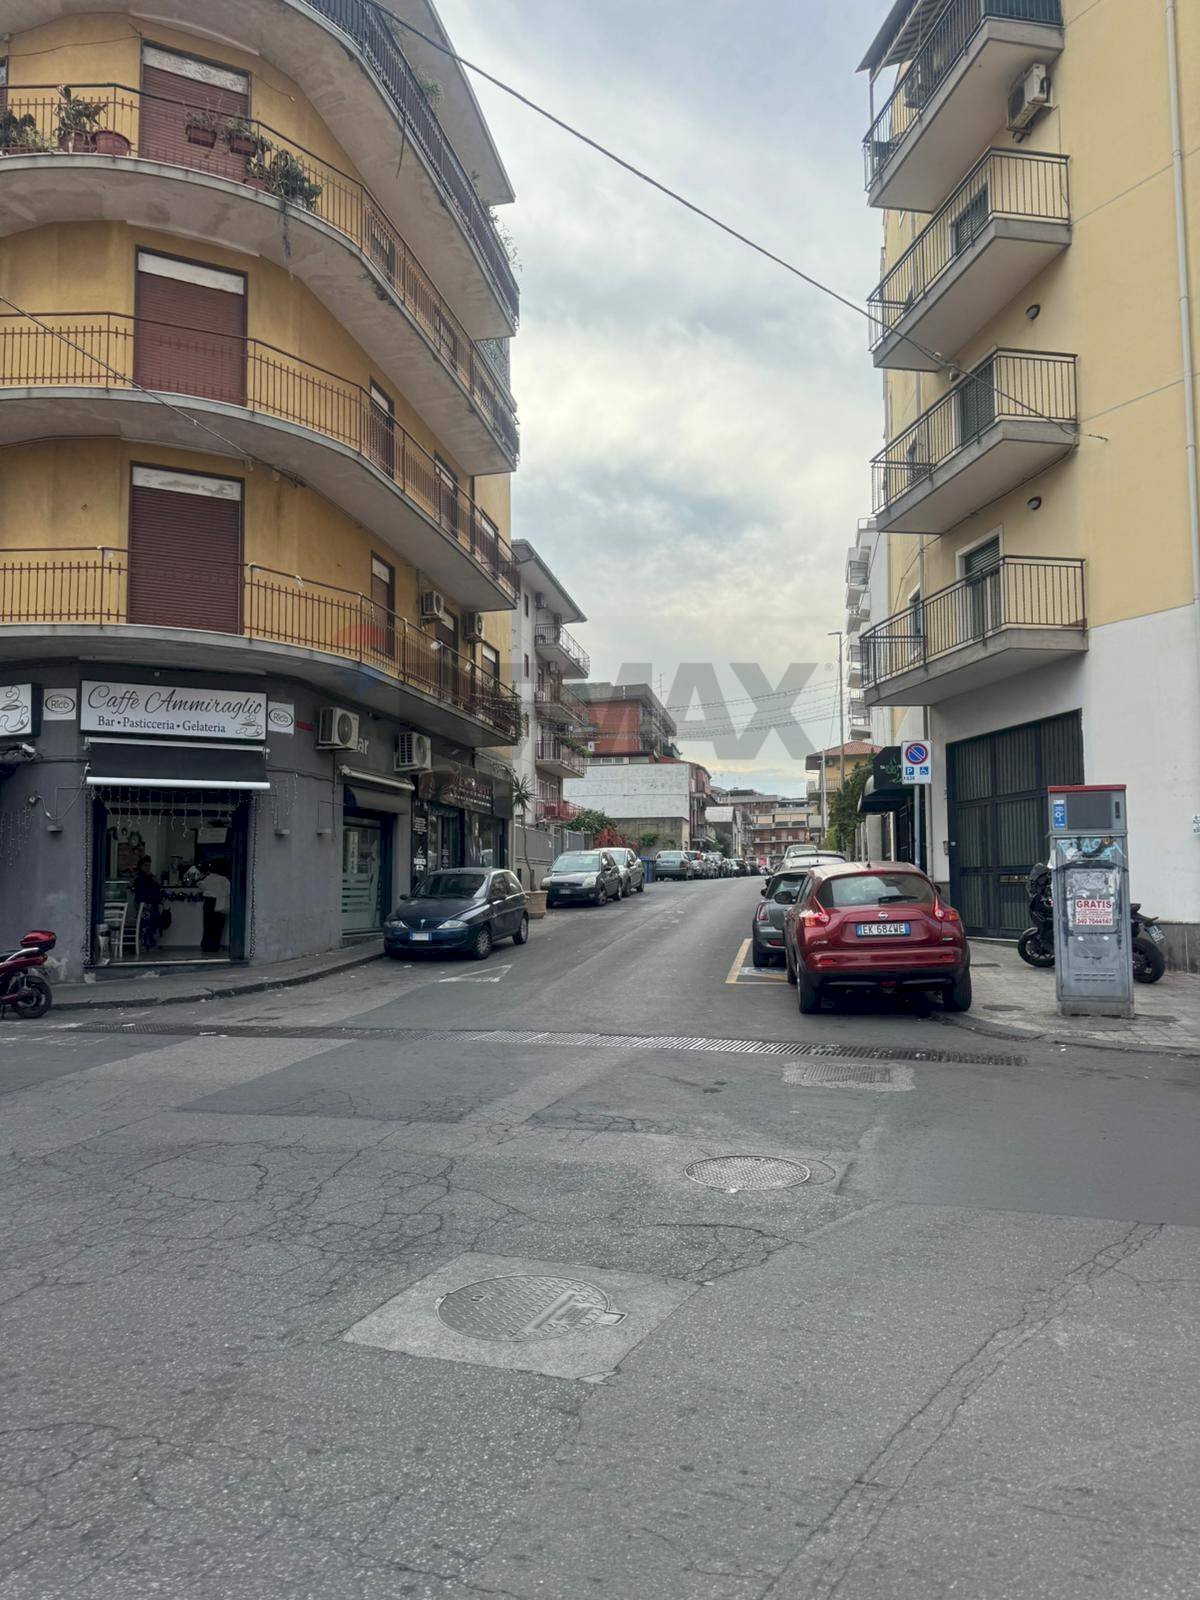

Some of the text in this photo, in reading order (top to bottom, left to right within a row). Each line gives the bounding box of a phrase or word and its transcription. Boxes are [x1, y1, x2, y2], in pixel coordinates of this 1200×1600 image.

[145, 689, 262, 720] Ammiraglio
[98, 716, 226, 733] Bar Pasticceria Gelateria
[1076, 900, 1112, 909] GRATIS
[862, 924, 873, 935] EK
